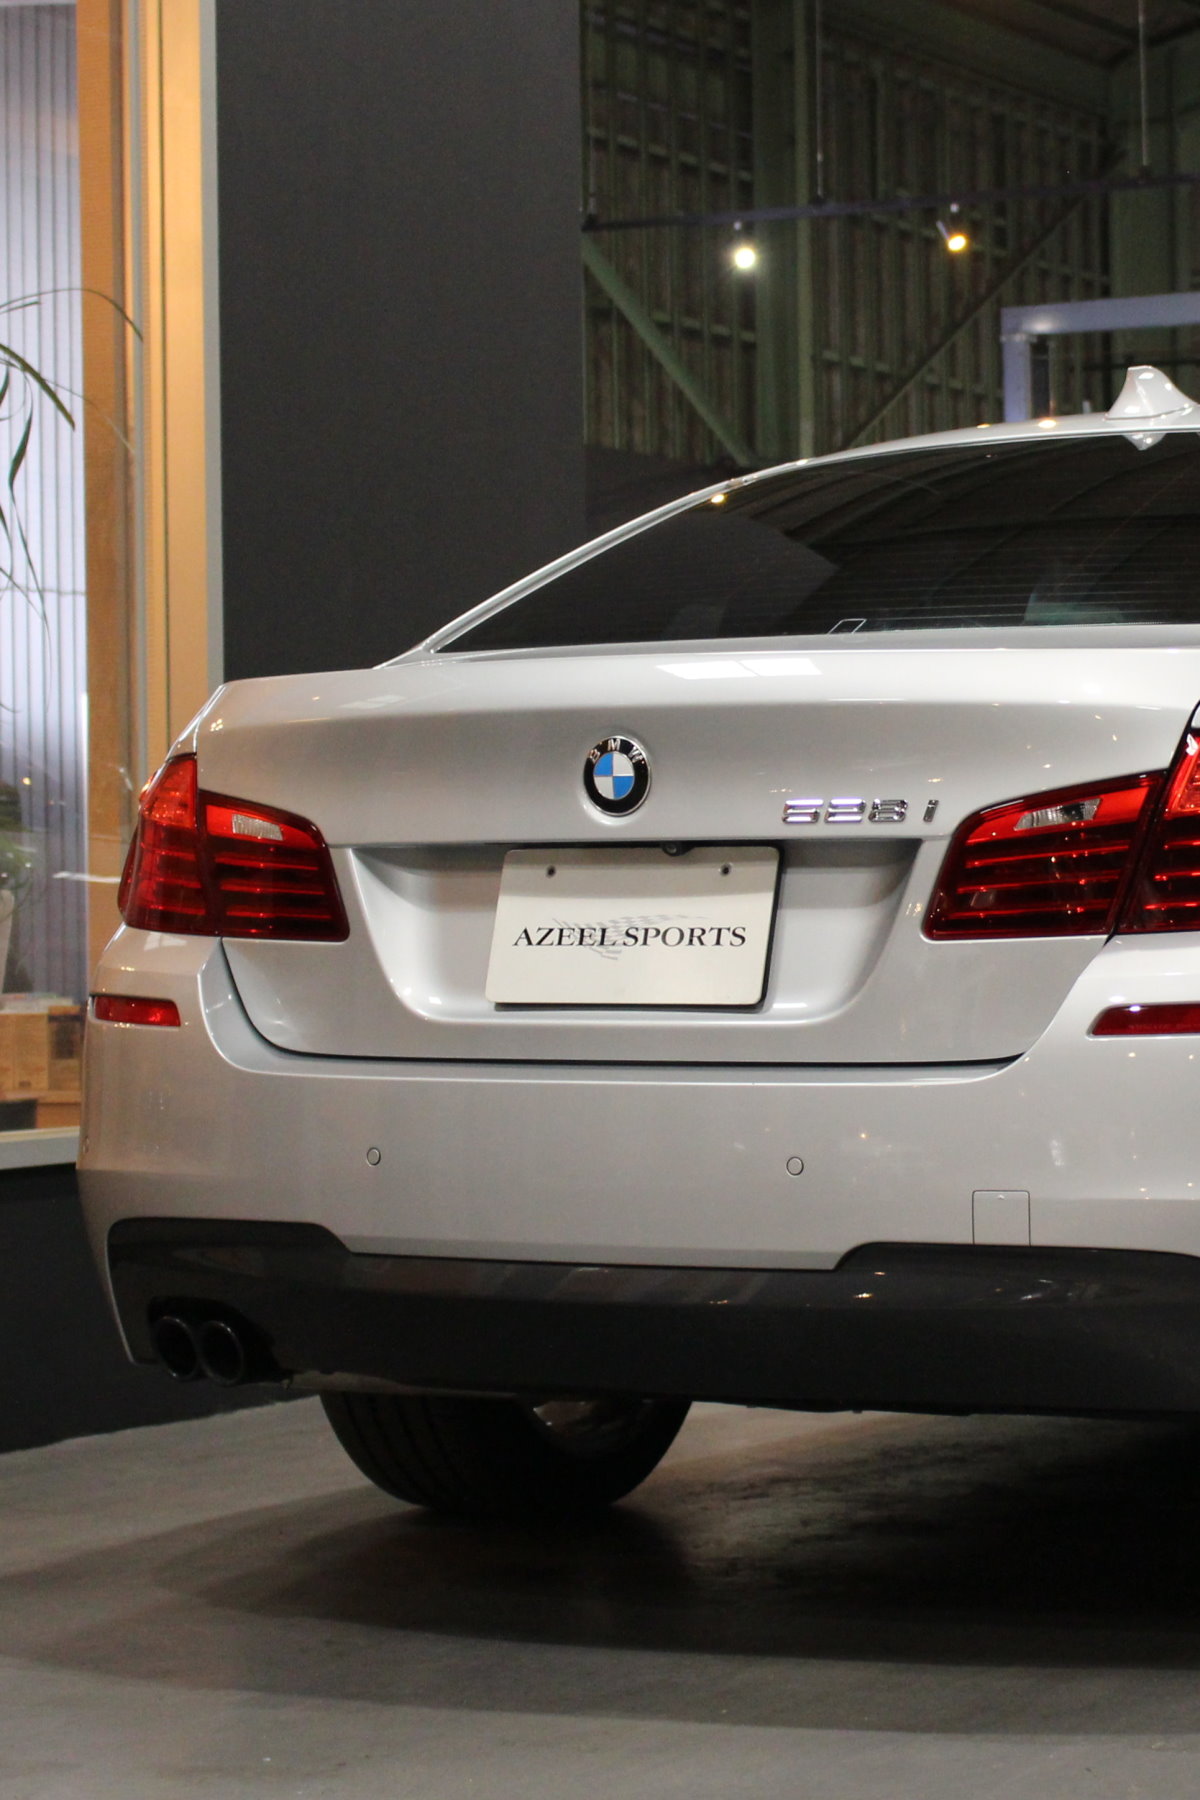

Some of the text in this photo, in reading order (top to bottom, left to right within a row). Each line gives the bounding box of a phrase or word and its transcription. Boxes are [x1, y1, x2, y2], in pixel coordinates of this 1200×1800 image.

[588, 738, 643, 764] BMW
[782, 798, 939, 823] 528i
[513, 926, 747, 948] AZEEL SPORTS
